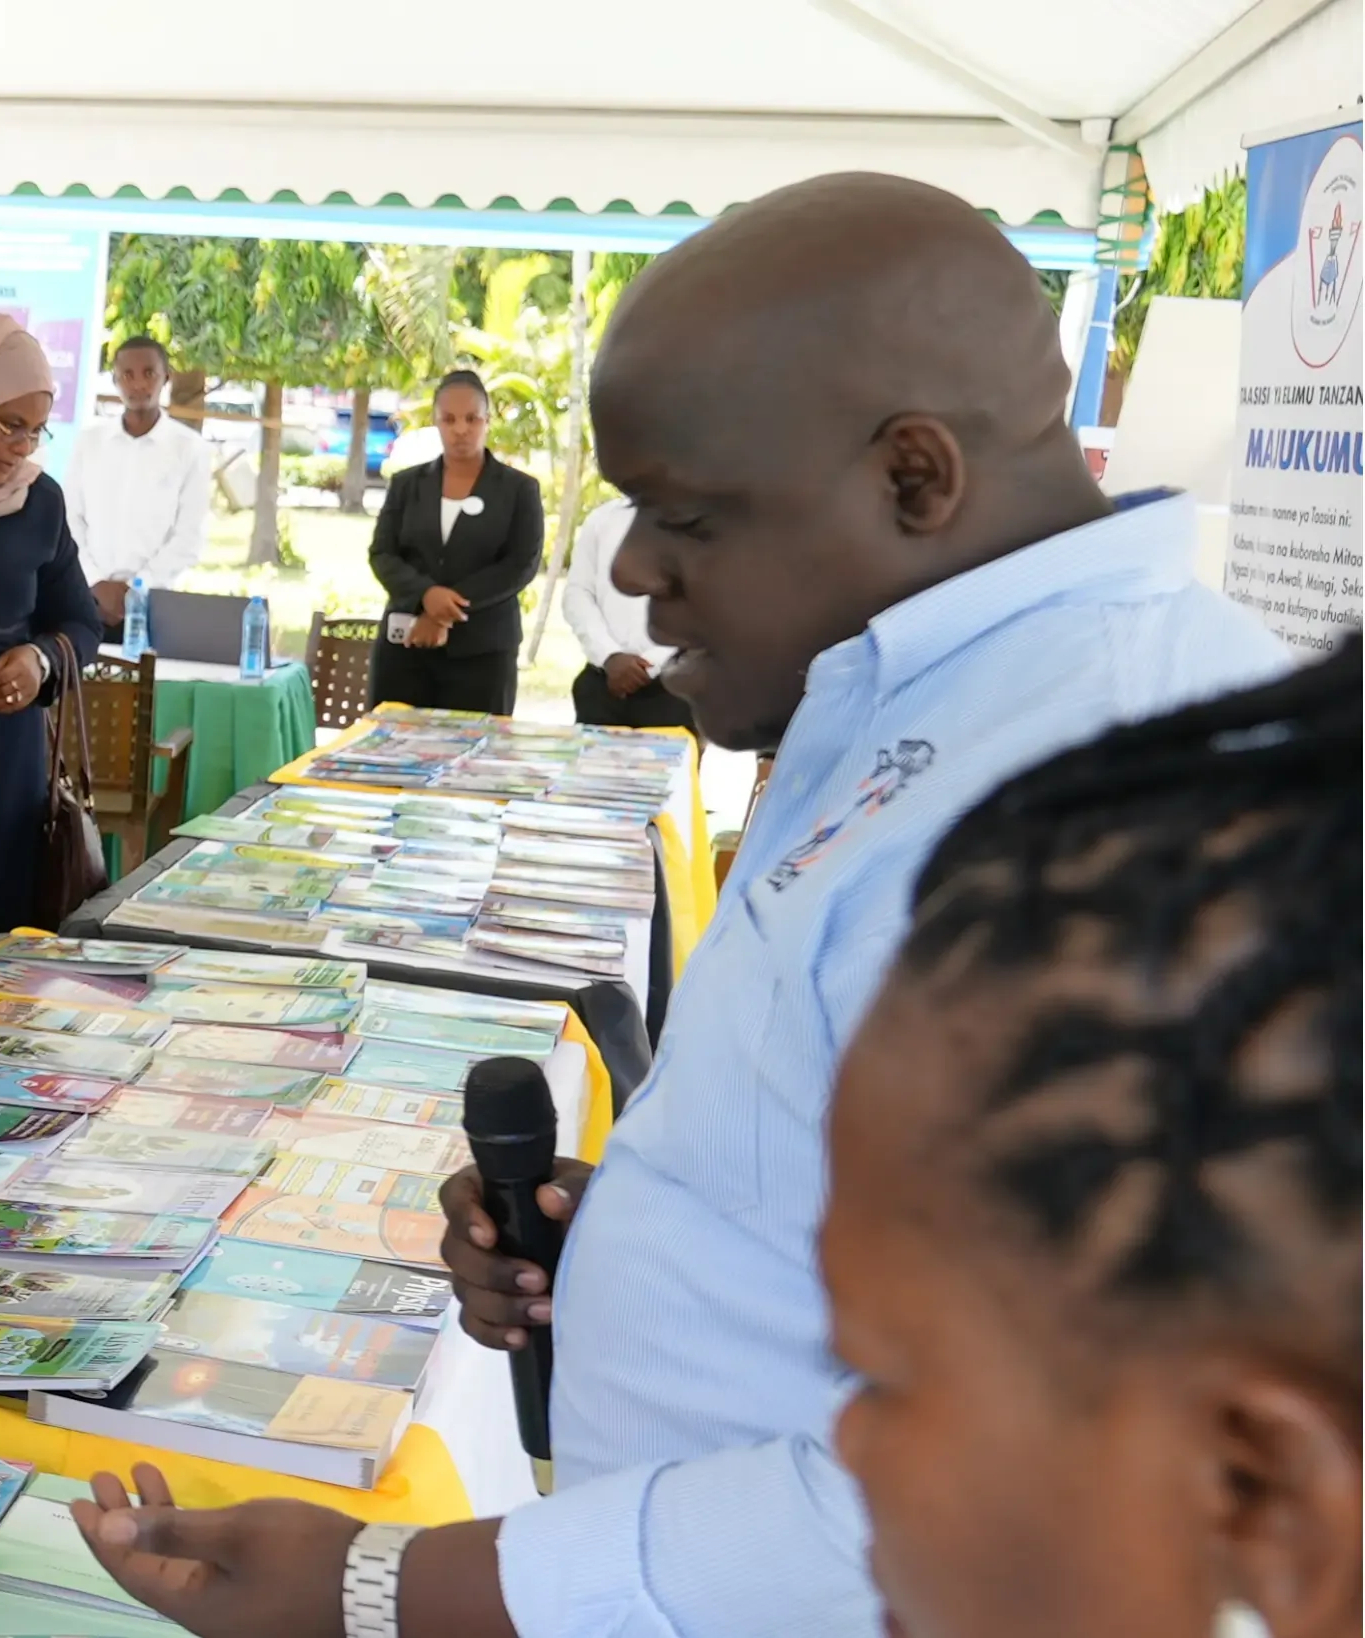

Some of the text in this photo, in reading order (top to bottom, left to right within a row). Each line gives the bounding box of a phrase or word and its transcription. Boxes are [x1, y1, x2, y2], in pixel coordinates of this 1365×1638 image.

[1298, 510, 1309, 527] ya
[1276, 544, 1287, 558] na
[1289, 540, 1330, 563] kuboresha
[1305, 572, 1337, 598] Msingi,
[390, 1275, 449, 1314] Physics
